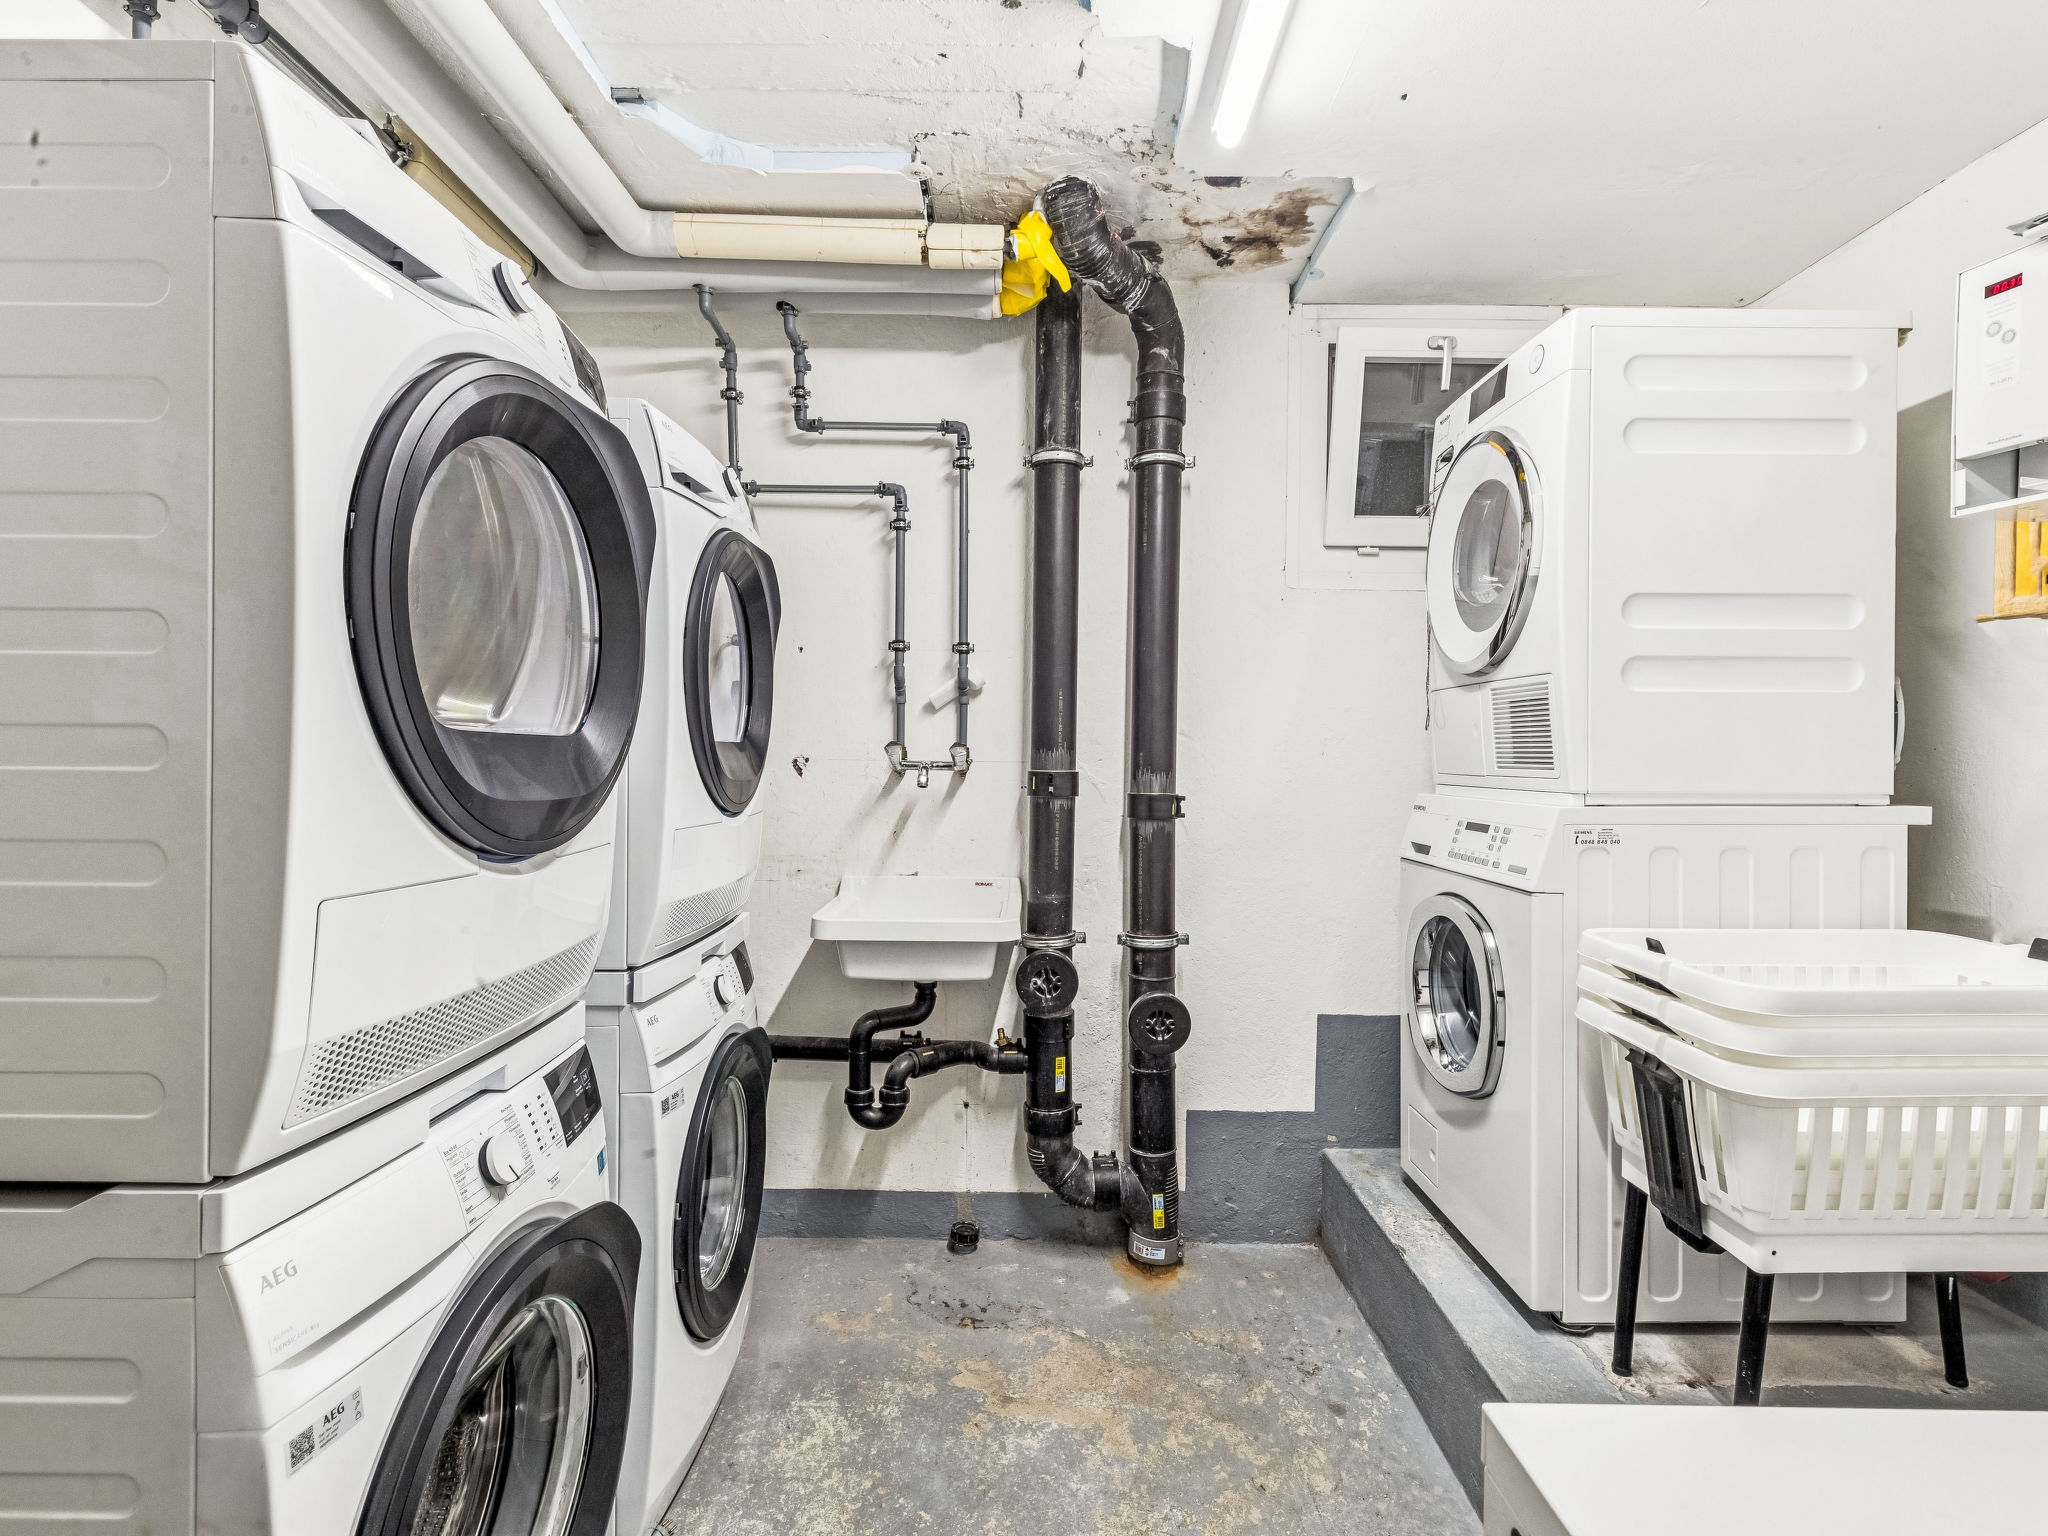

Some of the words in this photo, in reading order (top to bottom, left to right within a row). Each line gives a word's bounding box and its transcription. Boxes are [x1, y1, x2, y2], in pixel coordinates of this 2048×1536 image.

[646, 1014, 659, 1027] AEG
[260, 1259, 298, 1296] AEG
[322, 1401, 345, 1428] AEG
